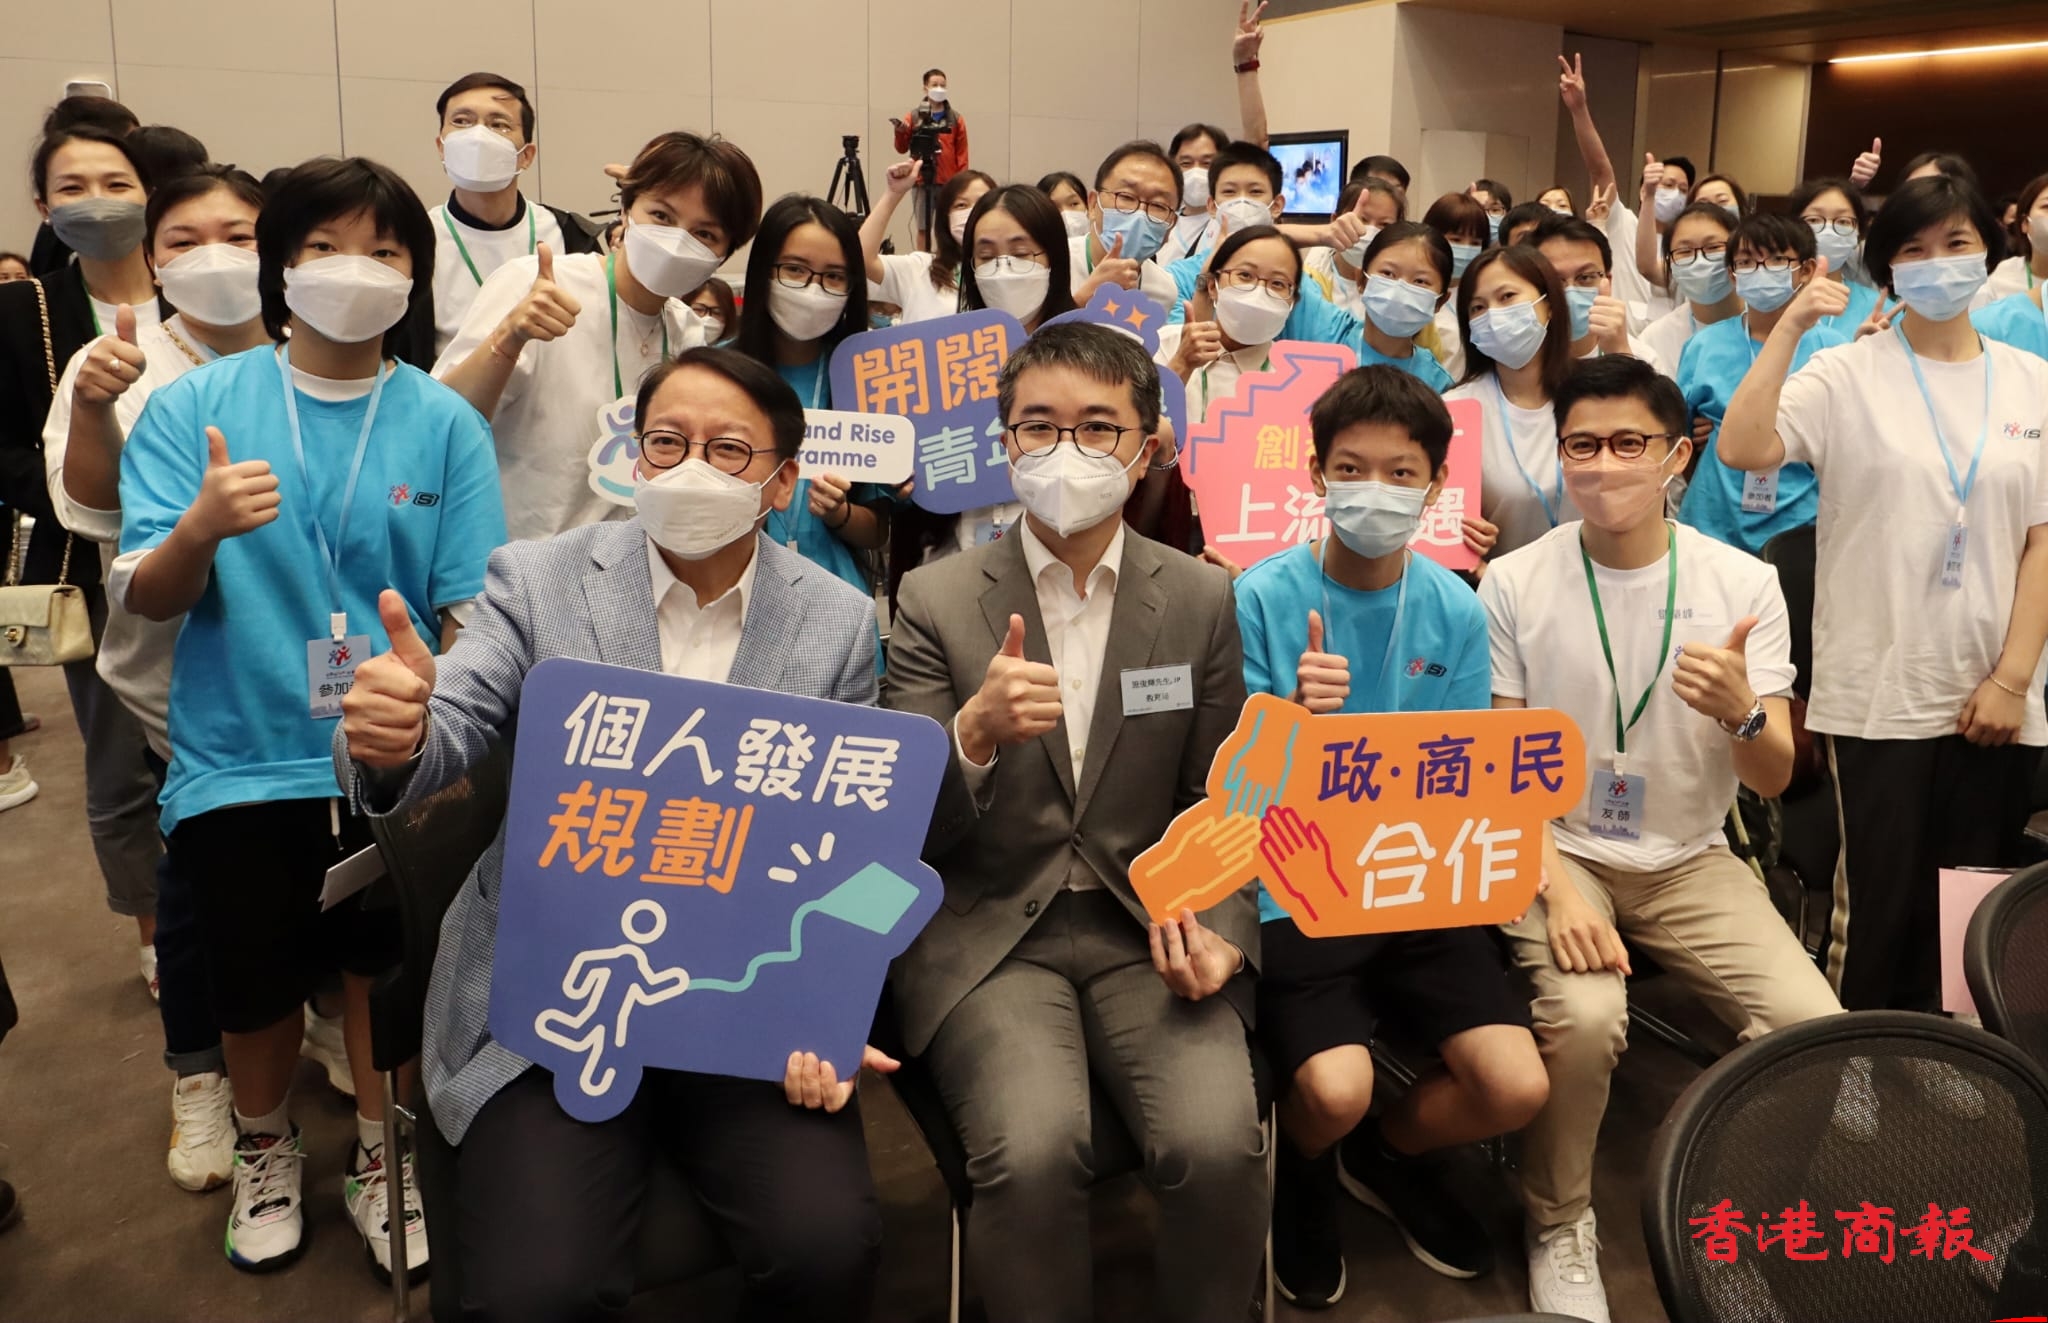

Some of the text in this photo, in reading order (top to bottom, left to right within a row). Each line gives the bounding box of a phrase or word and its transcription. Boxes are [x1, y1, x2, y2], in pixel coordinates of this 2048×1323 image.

[853, 324, 1008, 415] 開闊
[796, 450, 877, 468] ramme
[850, 423, 896, 444] Rise
[1254, 424, 1317, 471] 創
[1215, 483, 1466, 547] 上流遇
[318, 681, 356, 698] 參加
[564, 690, 900, 812] 個人發展
[1317, 731, 1564, 803] 政·商·民
[538, 780, 755, 894] 規劃
[1356, 818, 1523, 910] 合作
